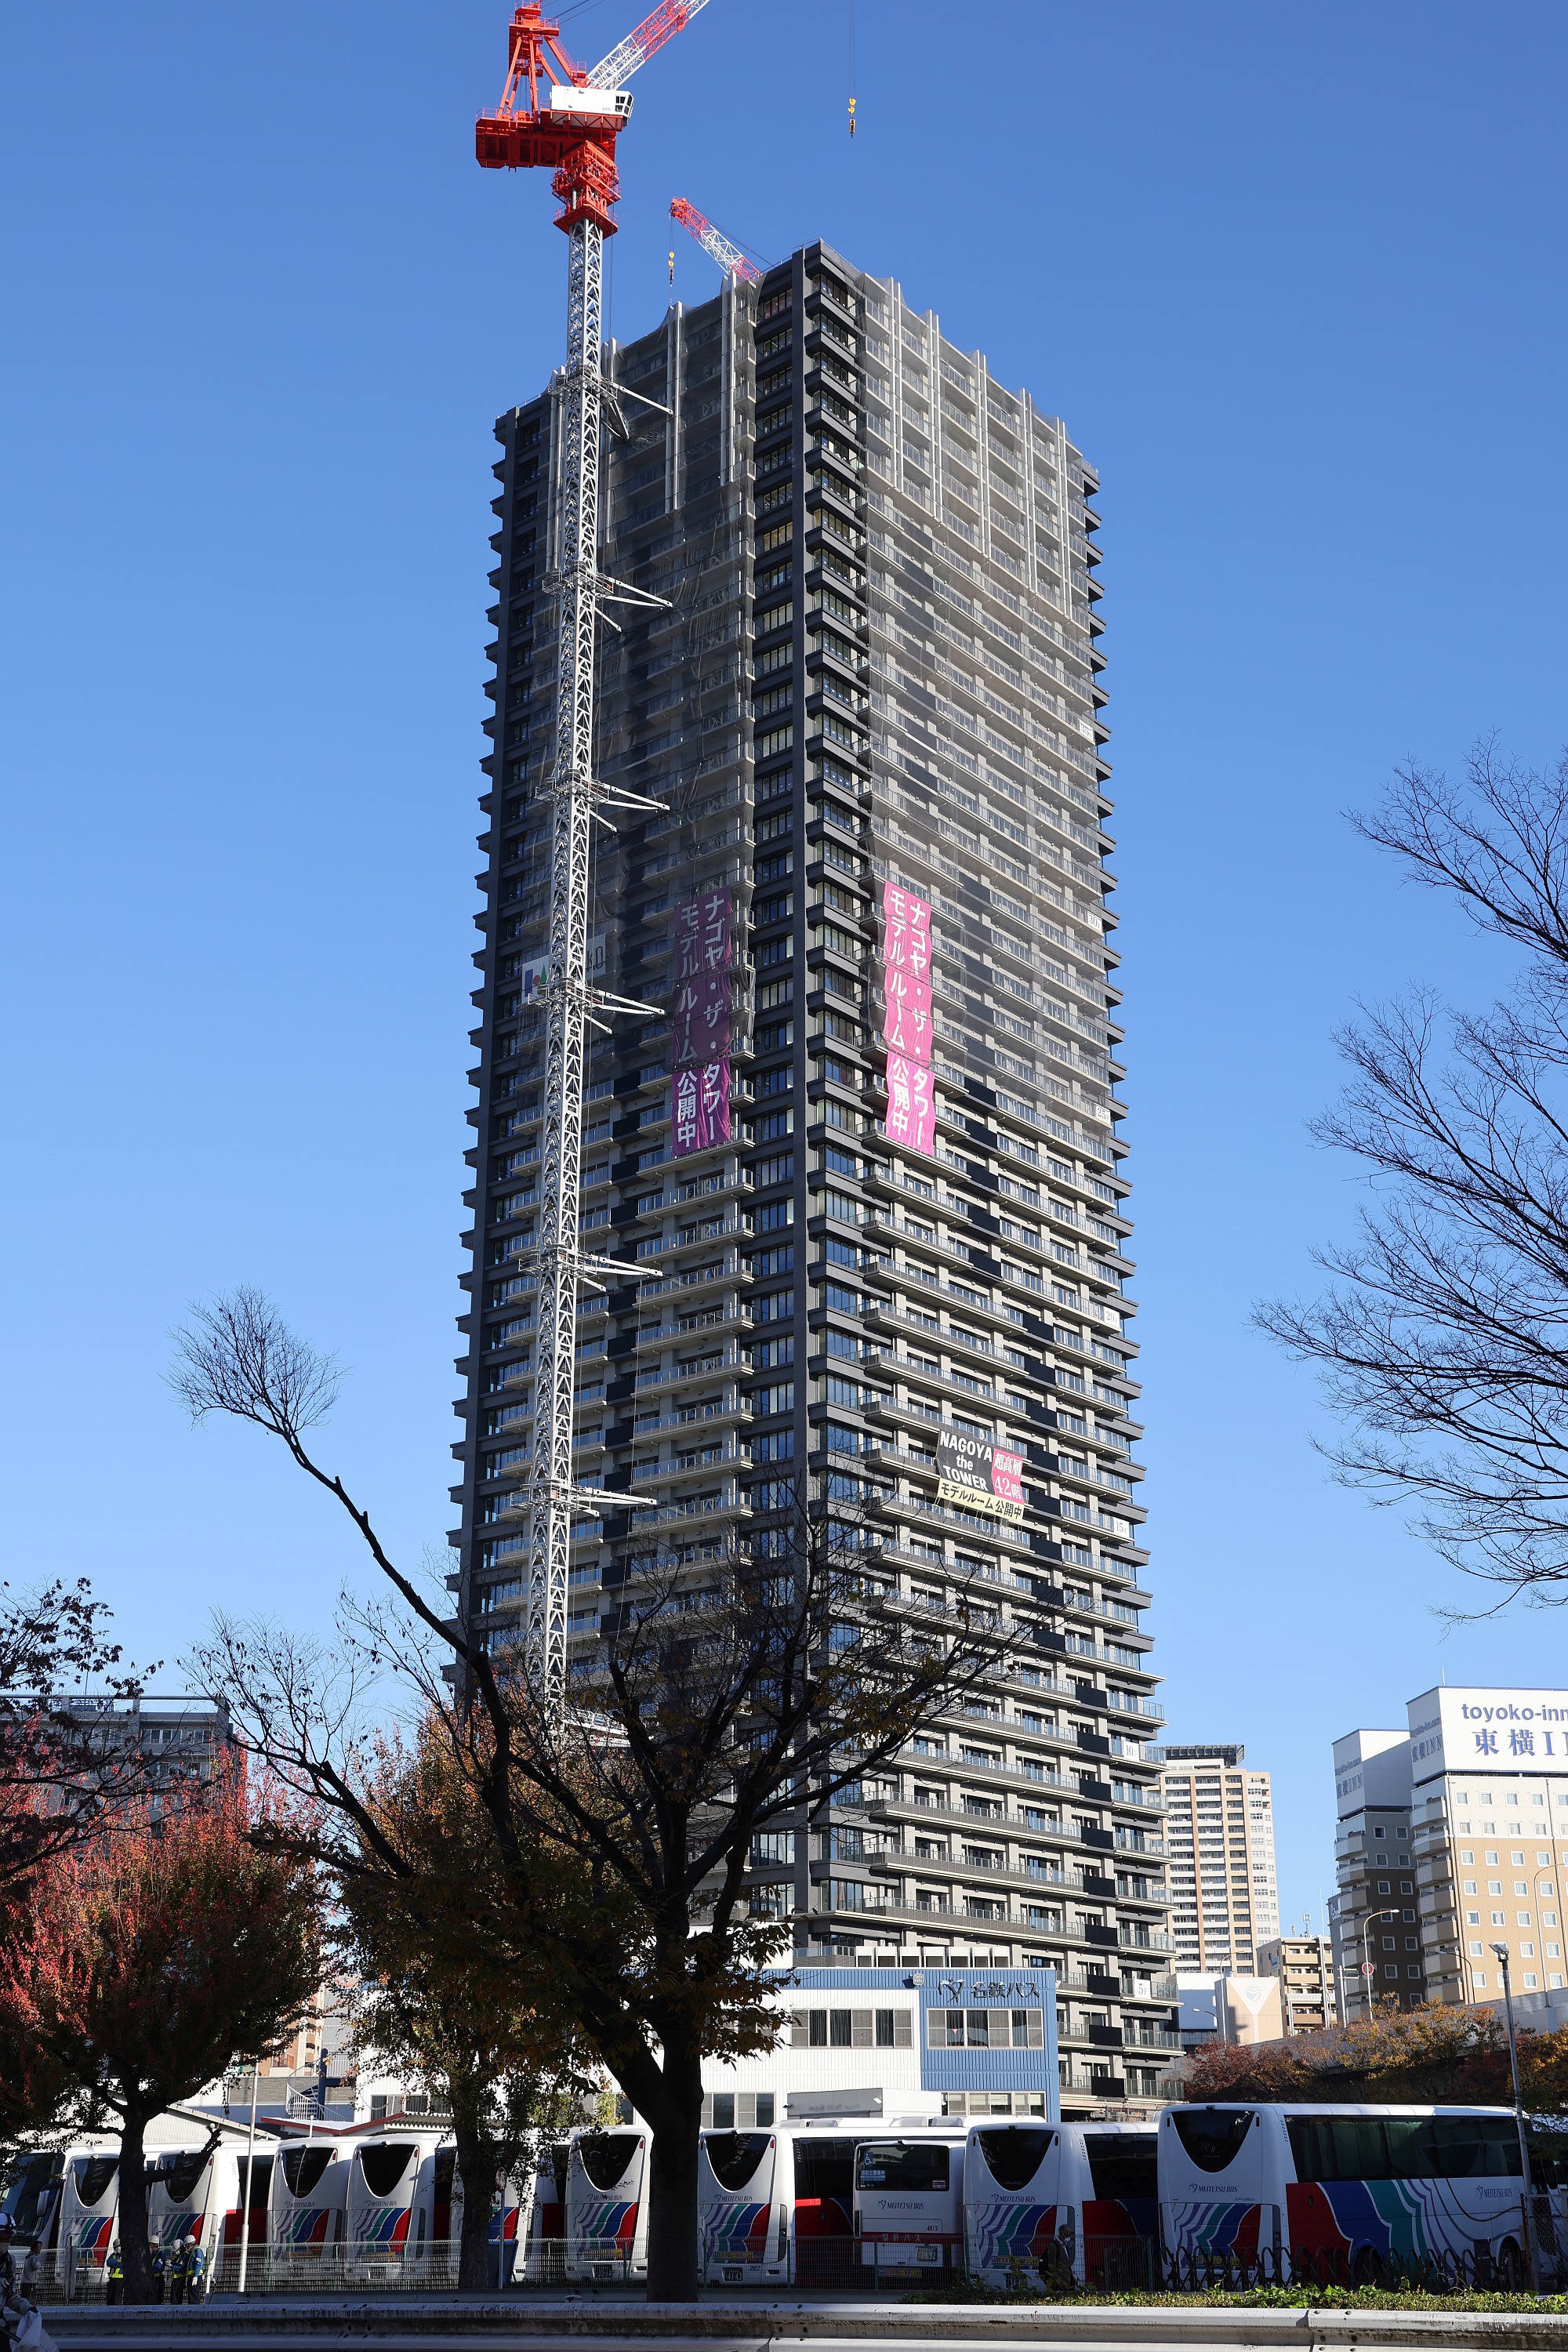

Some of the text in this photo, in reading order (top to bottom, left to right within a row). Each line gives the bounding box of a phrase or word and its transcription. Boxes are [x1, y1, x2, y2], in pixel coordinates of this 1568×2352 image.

[702, 895, 726, 1141] ナゴヤ・ザ・タワー
[890, 890, 910, 1137] モデルルーム公開中
[909, 902, 928, 1146] ナゴヤ・ザ・タワー
[677, 903, 699, 1148] モデルルーム公開中
[940, 1431, 993, 1462] NAGOYA
[956, 1455, 974, 1471] the
[994, 1452, 1022, 1477] 超高層
[943, 1465, 988, 1491] TOWER
[994, 1478, 1022, 1500] 42階
[1116, 1521, 1127, 1534] 15F
[1461, 1704, 1568, 1722] toyoko-inn
[971, 1981, 1040, 1998] 名鉄バス
[1138, 1983, 1148, 1995] 5F
[1483, 2187, 1512, 2198] MEITETSU BUS
